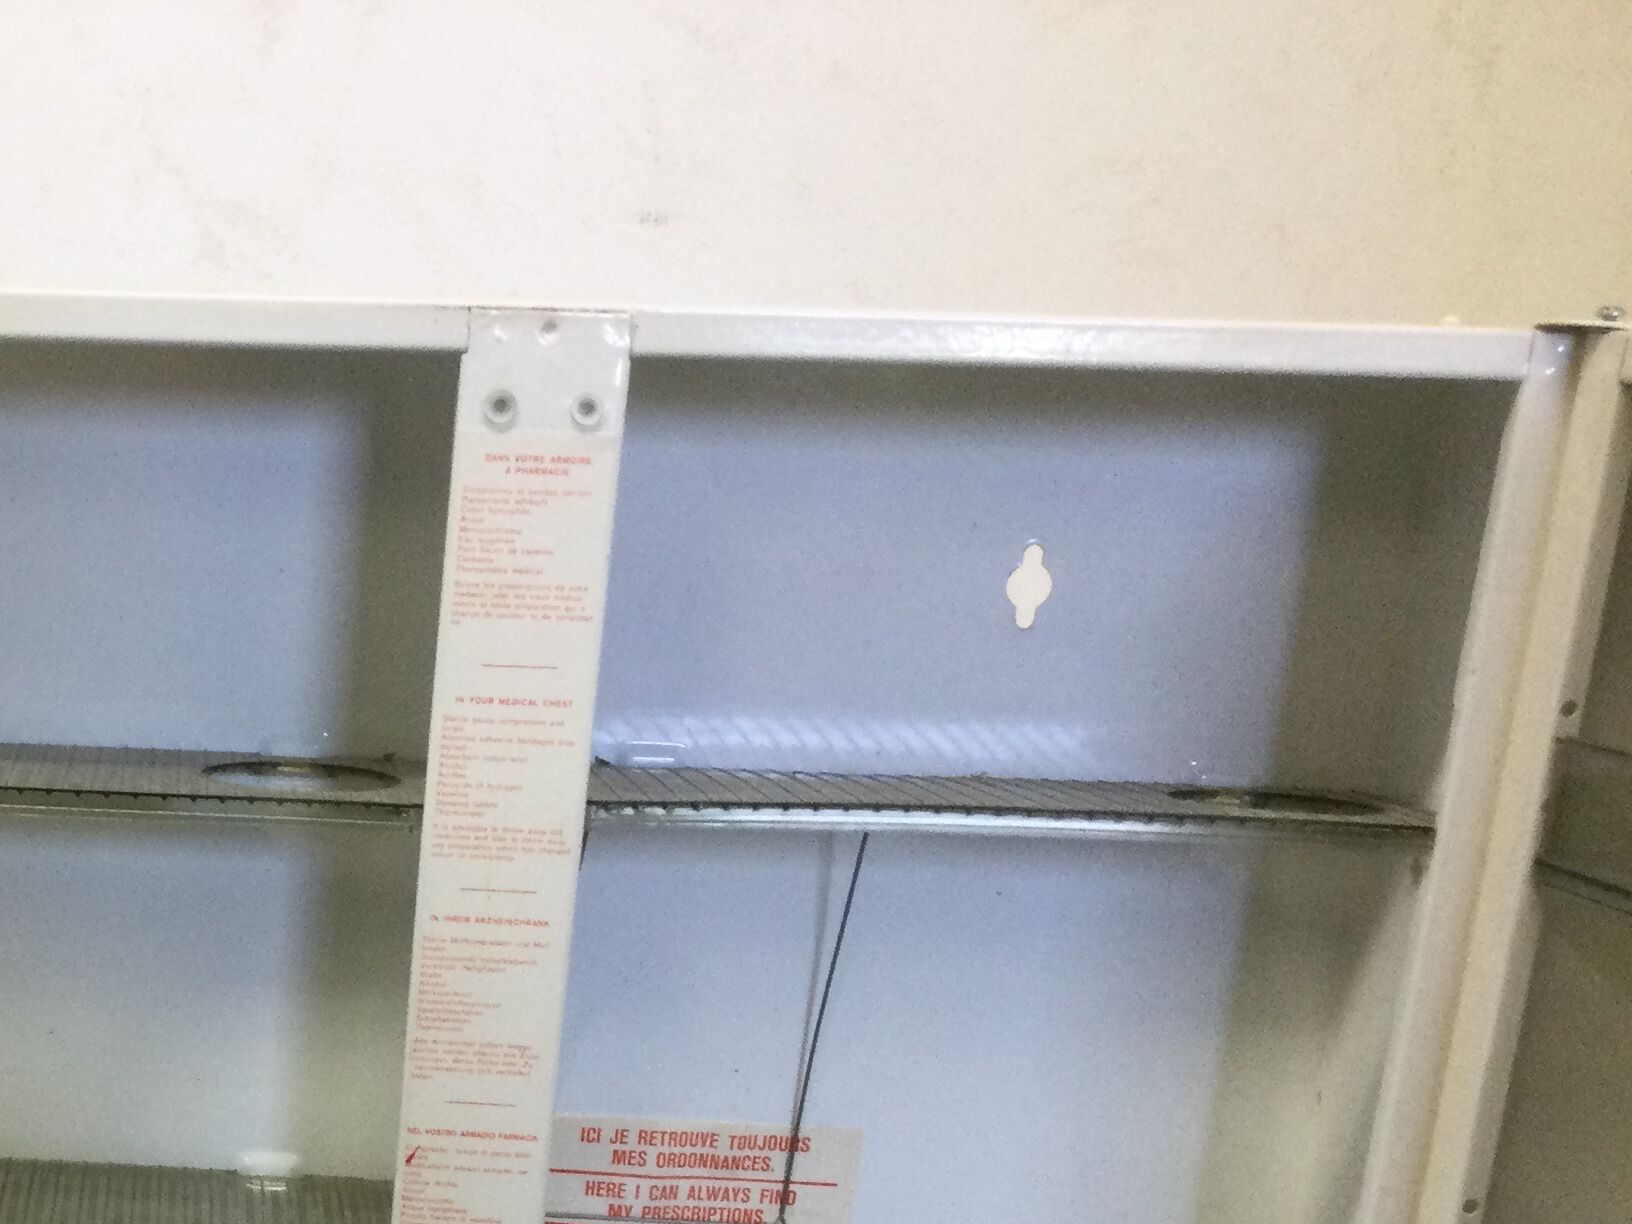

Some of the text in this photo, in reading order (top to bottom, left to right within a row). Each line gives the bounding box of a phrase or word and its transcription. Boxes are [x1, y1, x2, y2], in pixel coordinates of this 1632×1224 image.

[499, 698, 538, 707] MEDICAL
[543, 699, 573, 708] CHEST
[580, 1127, 811, 1153] ICI JE RETROUVE TOUJOUS
[611, 1149, 647, 1167] MES
[585, 1180, 627, 1198] HERE
[634, 1183, 640, 1198] I
[649, 1184, 679, 1201] CAN
[687, 1186, 751, 1204] ALWAYS
[608, 1203, 633, 1218] MY
